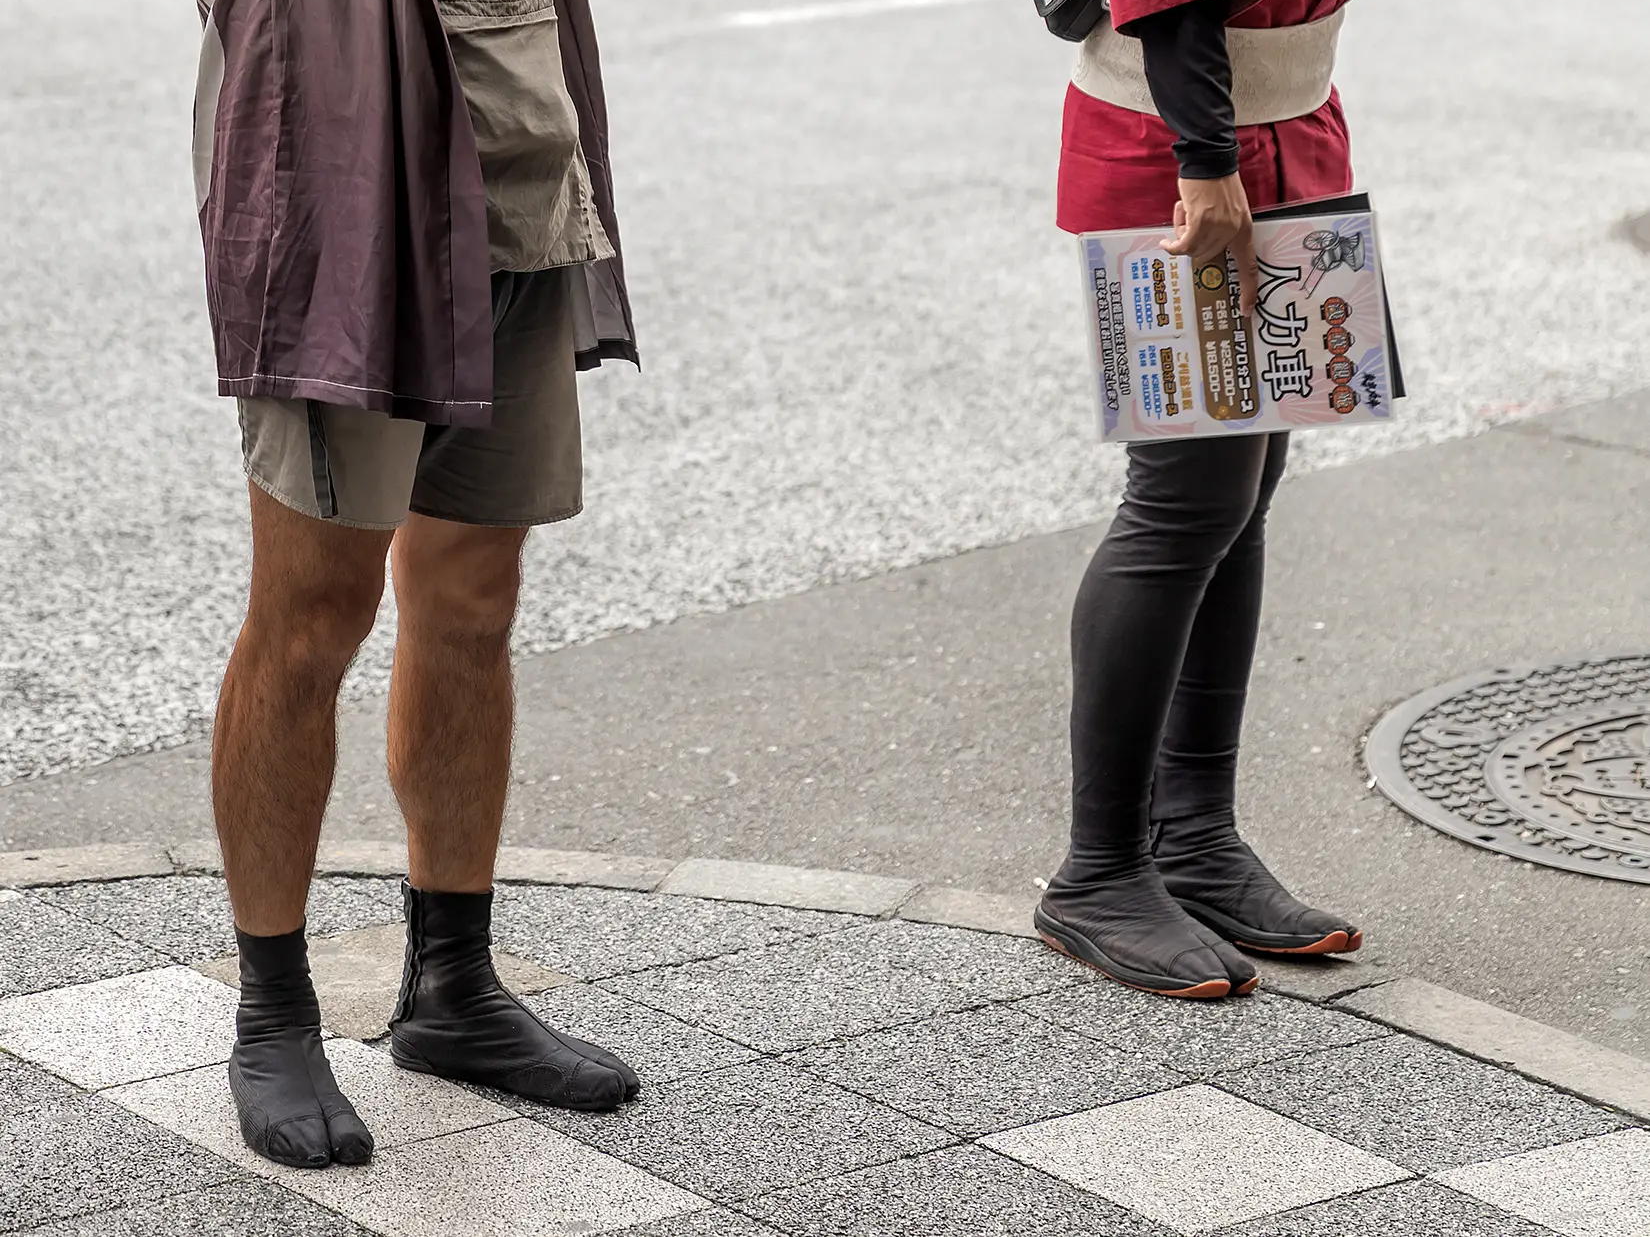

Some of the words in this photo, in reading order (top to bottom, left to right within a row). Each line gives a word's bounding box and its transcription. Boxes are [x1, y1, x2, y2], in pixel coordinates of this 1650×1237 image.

[1150, 258, 1169, 326] 45分コース
[1253, 253, 1315, 402] 人力車
[1159, 347, 1178, 415] 120分コース
